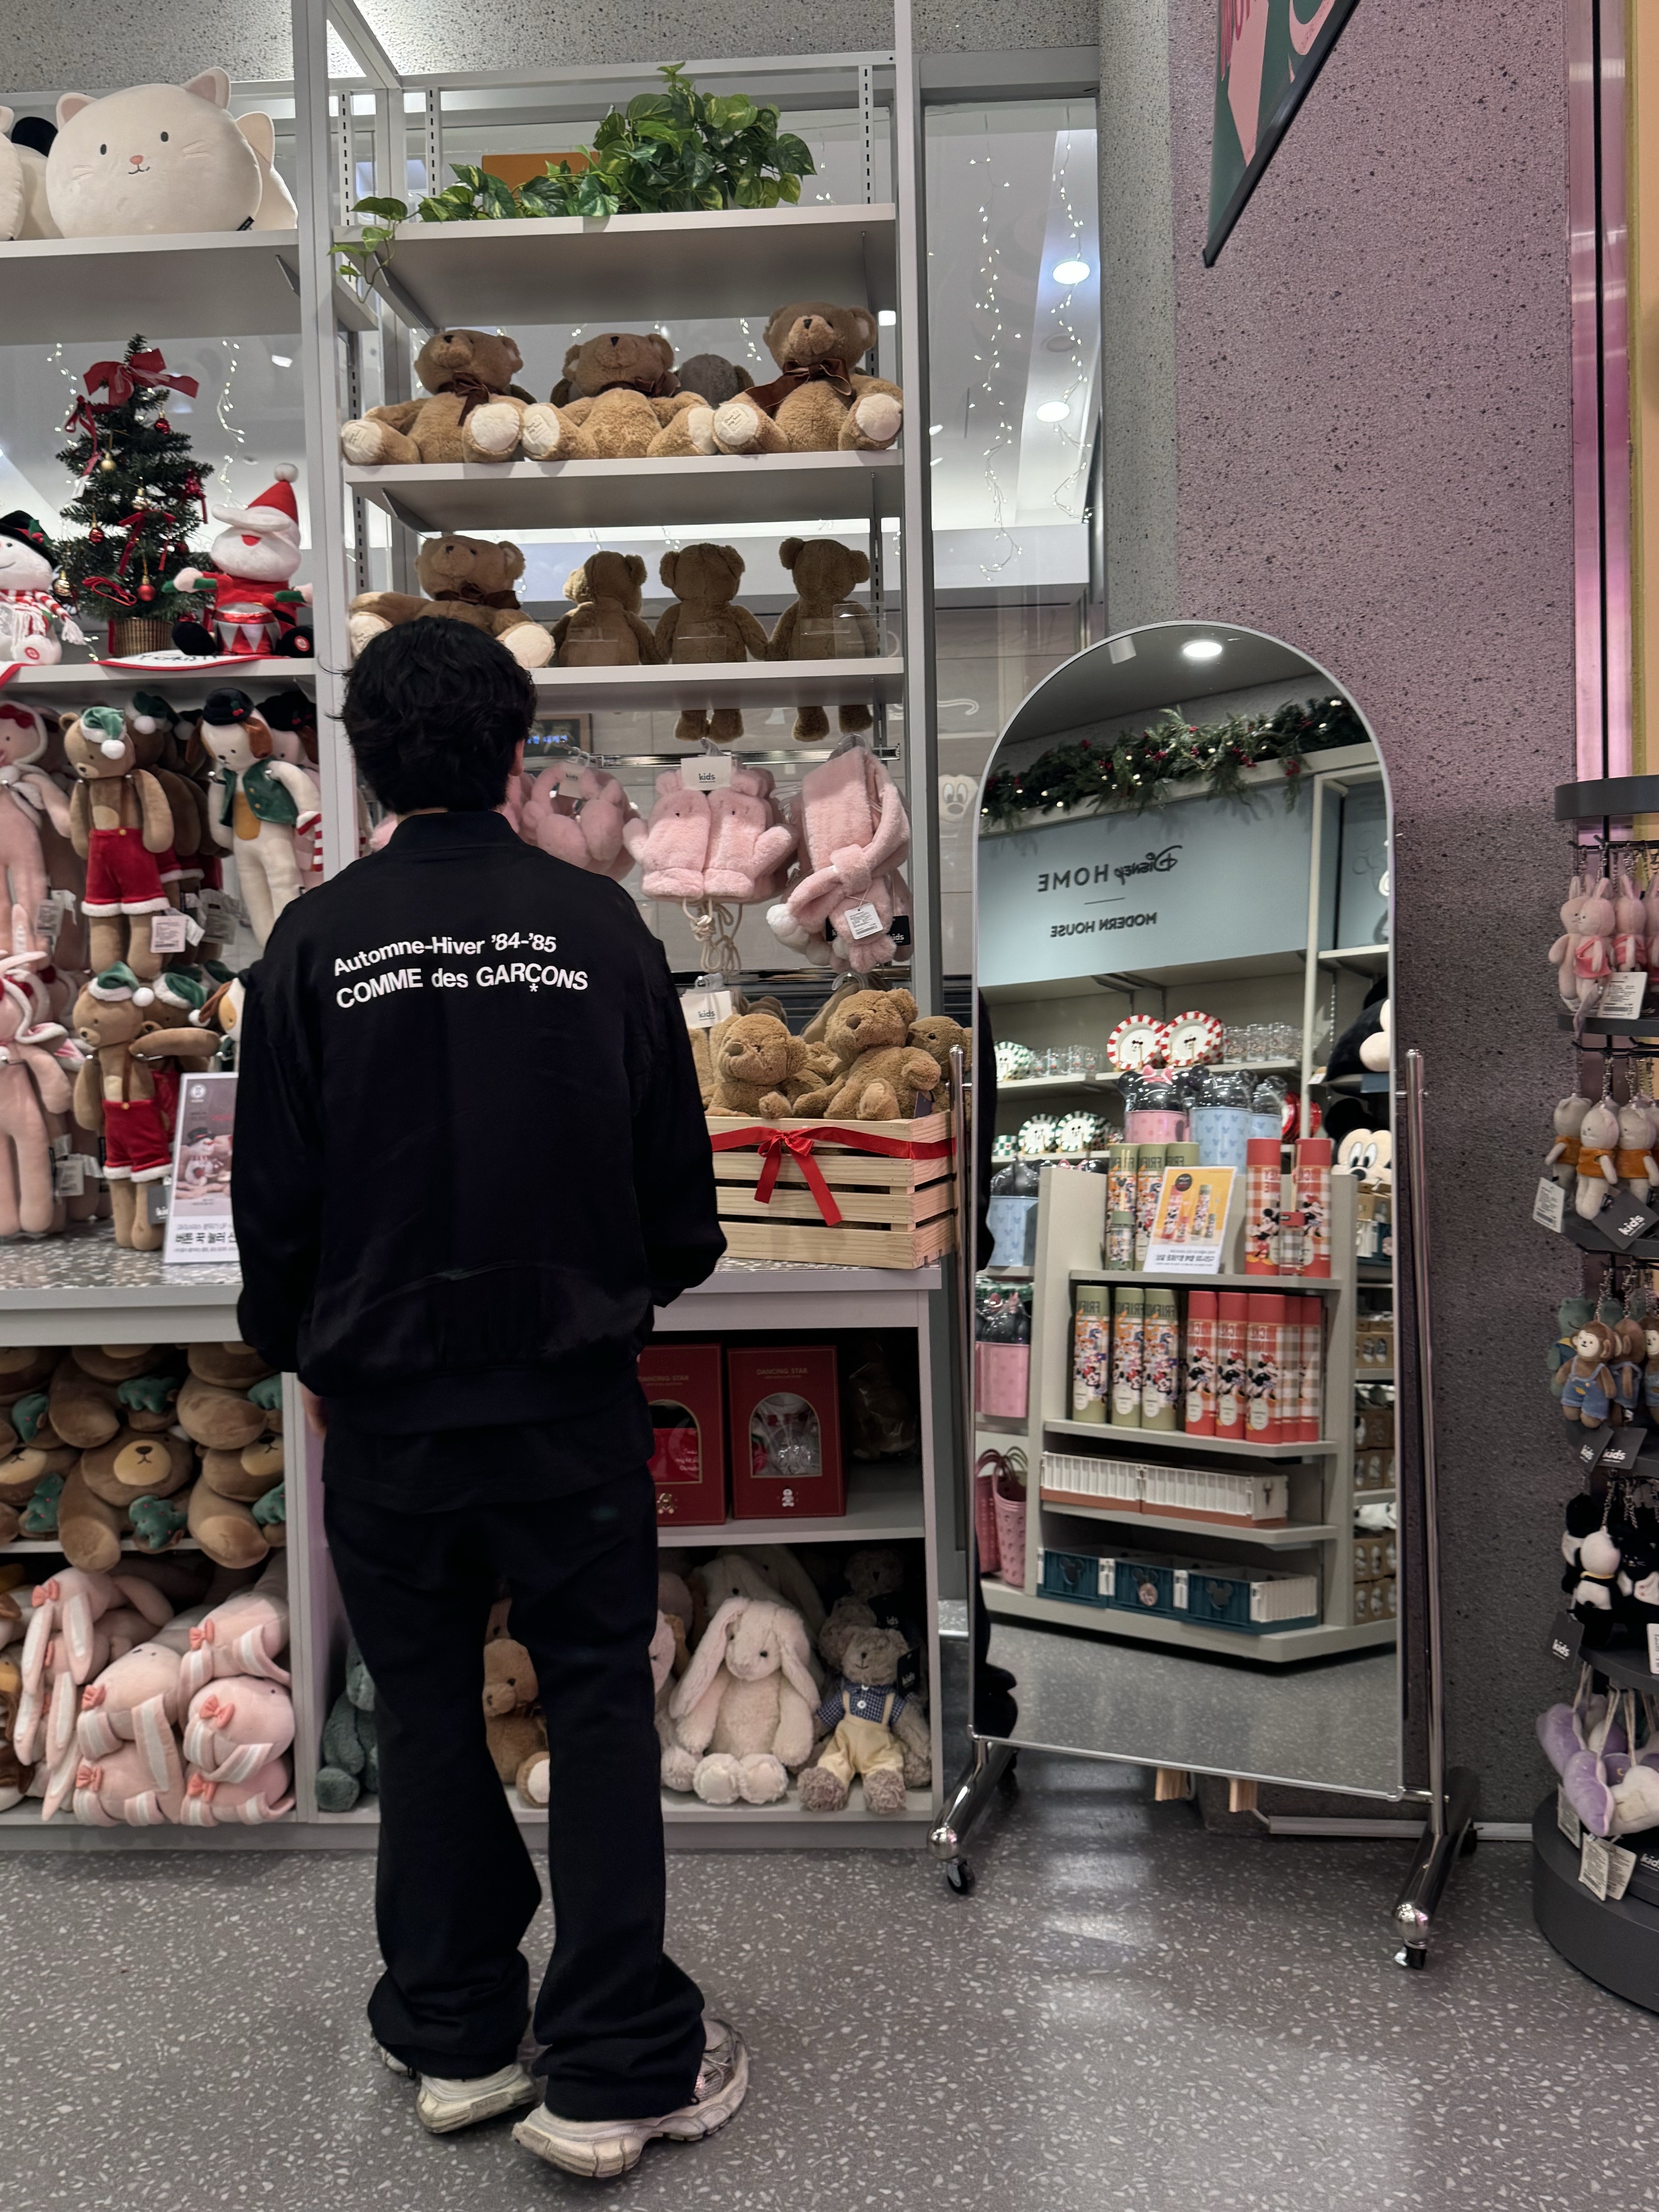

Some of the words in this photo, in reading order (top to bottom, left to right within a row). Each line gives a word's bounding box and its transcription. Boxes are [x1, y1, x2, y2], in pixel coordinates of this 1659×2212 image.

[334, 936, 485, 976] Automne-Hiver
[491, 932, 557, 953] '84-'85
[336, 968, 423, 1008] COMME
[431, 967, 469, 988] des
[1618, 1215, 1645, 1235] kids
[1602, 1448, 1626, 1460] kids
[1552, 1639, 1570, 1657] kids
